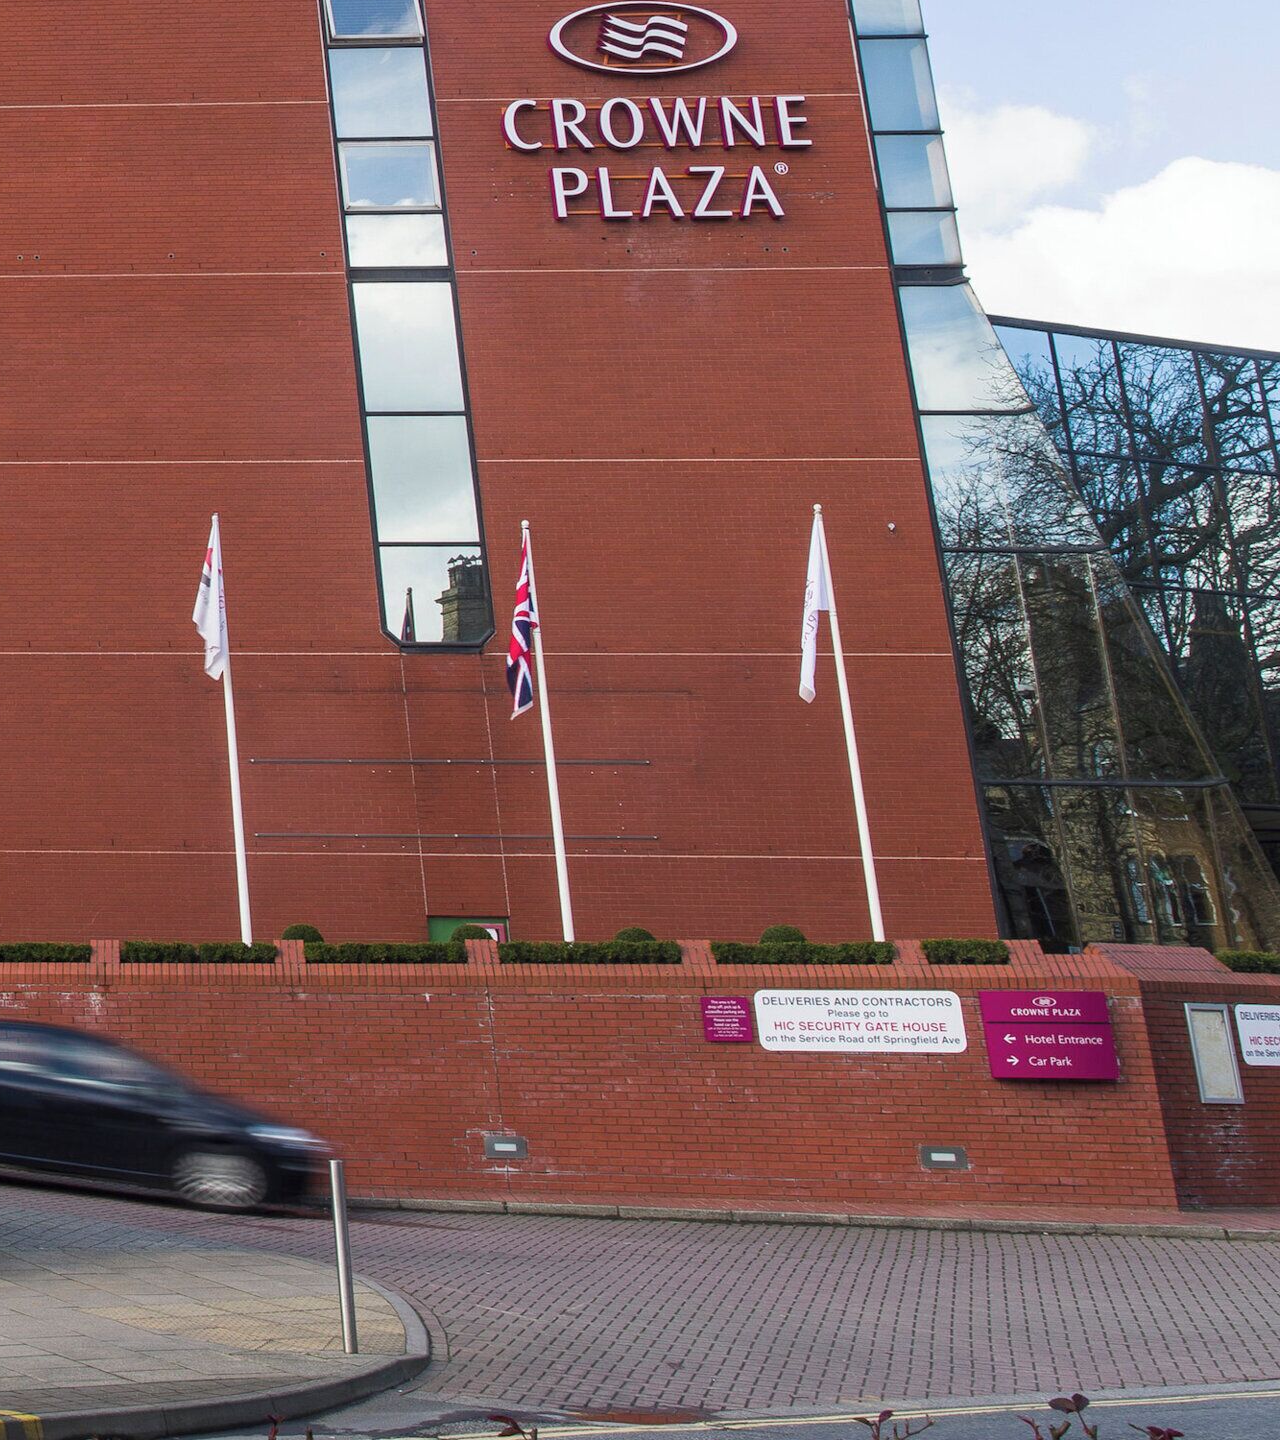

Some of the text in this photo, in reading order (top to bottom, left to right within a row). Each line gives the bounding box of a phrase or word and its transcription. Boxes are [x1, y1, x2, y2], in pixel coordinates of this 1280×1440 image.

[501, 96, 813, 152] CROWNE
[762, 997, 952, 1007] DELIVERIES AND CONTRACTORS
[828, 1009, 889, 1019] Please go to
[1010, 1008, 1081, 1017] CROWNE PLAZA
[1240, 1012, 1280, 1021] DELIVERIES
[774, 1021, 948, 1032] HIC SECURITY GATE HOUSE
[780, 1034, 796, 1043] the
[798, 1034, 836, 1043] Service
[838, 1035, 864, 1043] Road
[867, 1035, 881, 1044] off
[883, 1035, 939, 1046] Springfield
[942, 1036, 960, 1045] Ave
[1025, 1034, 1103, 1045] Hotel Entrance
[1249, 1036, 1263, 1045] HIC
[1255, 1049, 1265, 1057] the
[1028, 1056, 1072, 1066] Car Park
